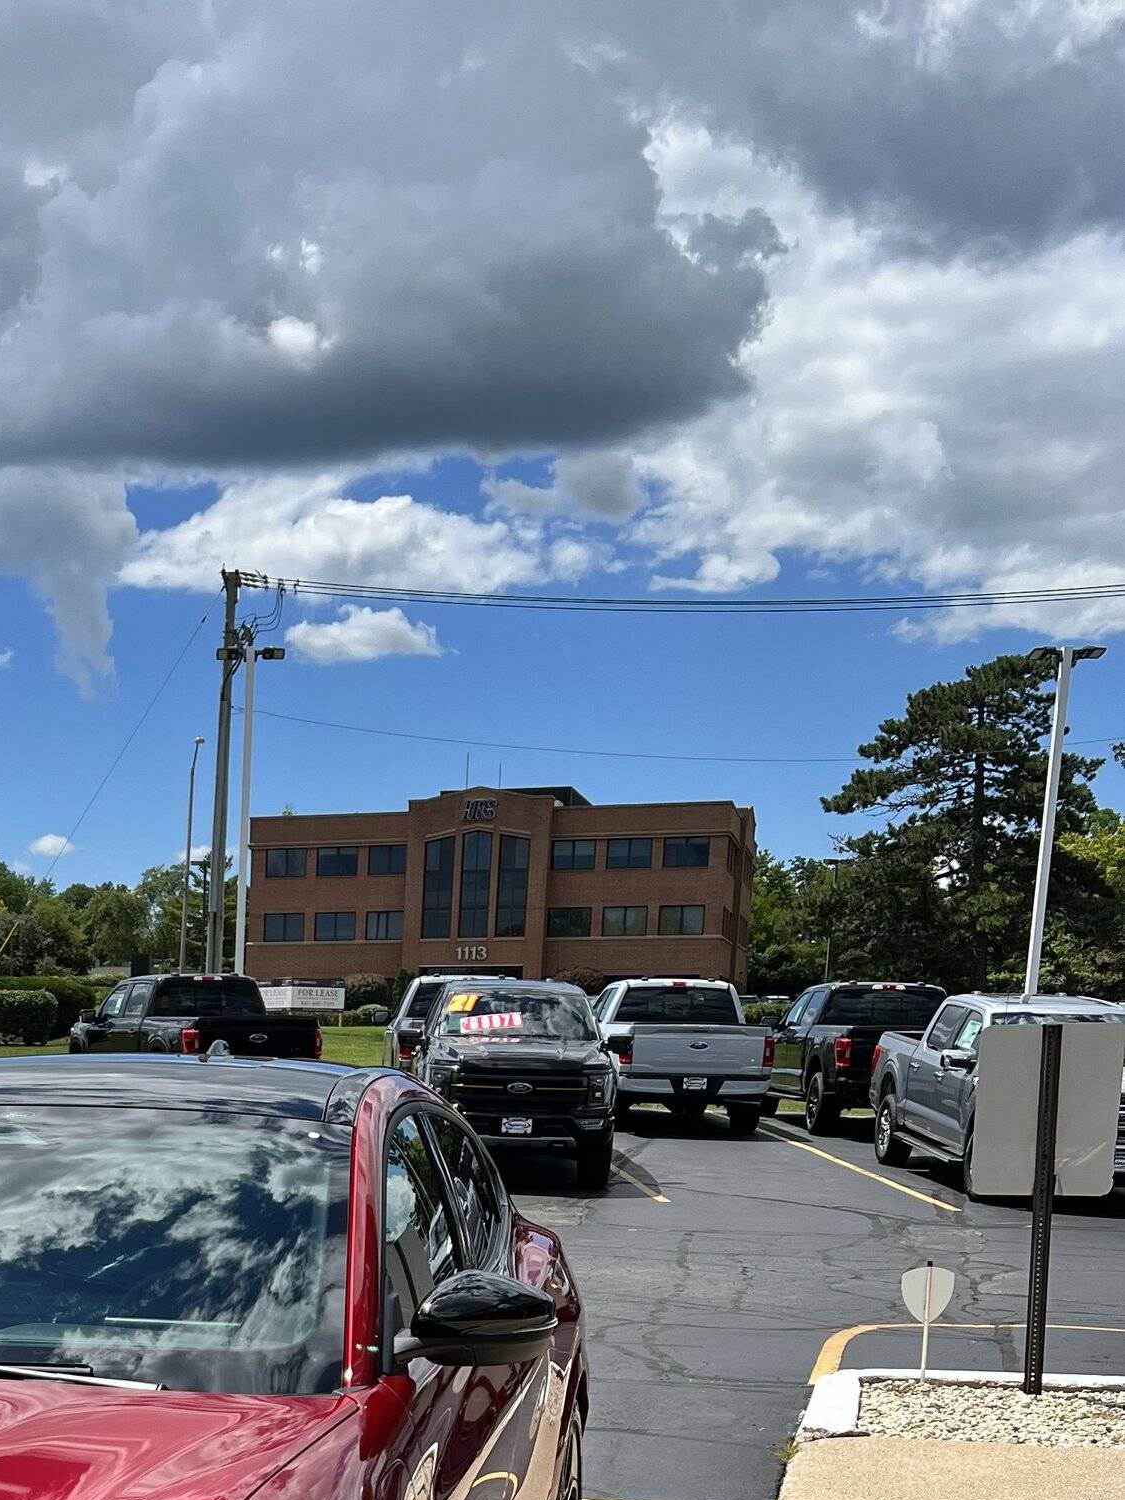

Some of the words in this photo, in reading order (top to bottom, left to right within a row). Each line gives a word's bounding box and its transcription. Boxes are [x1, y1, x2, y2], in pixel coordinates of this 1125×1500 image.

[455, 946, 487, 960] 1113
[298, 988, 314, 997] FOR
[315, 988, 339, 997] LEASE
[448, 994, 479, 1012] 21
